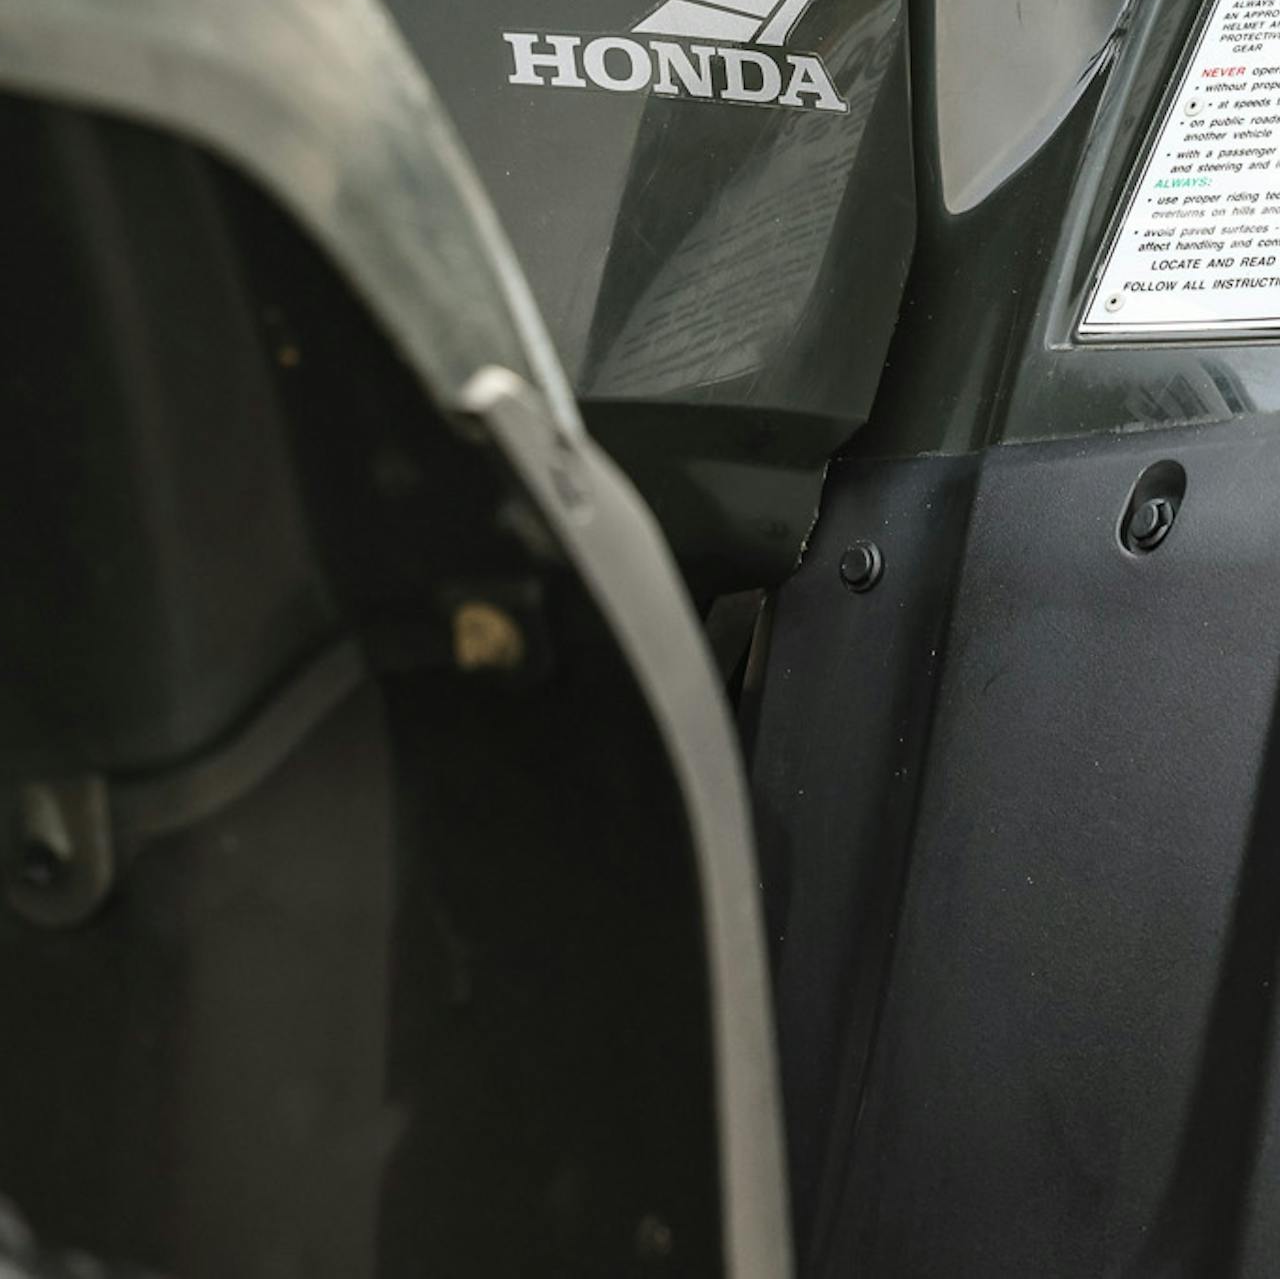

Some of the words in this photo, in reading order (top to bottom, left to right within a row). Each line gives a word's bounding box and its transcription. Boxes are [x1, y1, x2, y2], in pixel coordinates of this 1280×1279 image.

[1224, 12, 1238, 20] AN
[1222, 21, 1265, 31] HELMET
[1232, 43, 1263, 53] GEAR
[502, 32, 848, 112] HONDA
[1201, 66, 1247, 78] NEVER
[1205, 82, 1247, 92] without
[1217, 100, 1230, 109] at
[1233, 97, 1271, 109] speeds
[1189, 119, 1205, 129] on
[1209, 116, 1245, 129] public
[1183, 132, 1227, 142] another
[1233, 129, 1273, 140] vehicle
[1177, 149, 1200, 159] with
[1217, 147, 1277, 160] passenger
[1170, 163, 1193, 174] and
[1197, 162, 1243, 174] steering
[1248, 159, 1271, 170] and
[1157, 196, 1179, 205] use
[1183, 194, 1222, 205] proper
[1226, 192, 1260, 204] riding
[1151, 209, 1206, 219] overturns
[1211, 209, 1226, 217] on
[1232, 206, 1256, 215] hills
[1143, 227, 1177, 238] avoid
[1179, 225, 1217, 239] paved
[1220, 224, 1269, 235] surfaces
[1138, 241, 1171, 252] affect
[1175, 240, 1225, 252] handling
[1230, 238, 1253, 249] and
[1151, 258, 1201, 271] LOCATE
[1206, 258, 1235, 268] AND
[1239, 256, 1276, 267] READ
[1123, 280, 1177, 292] FOLLOW
[1182, 280, 1205, 290] ALL
